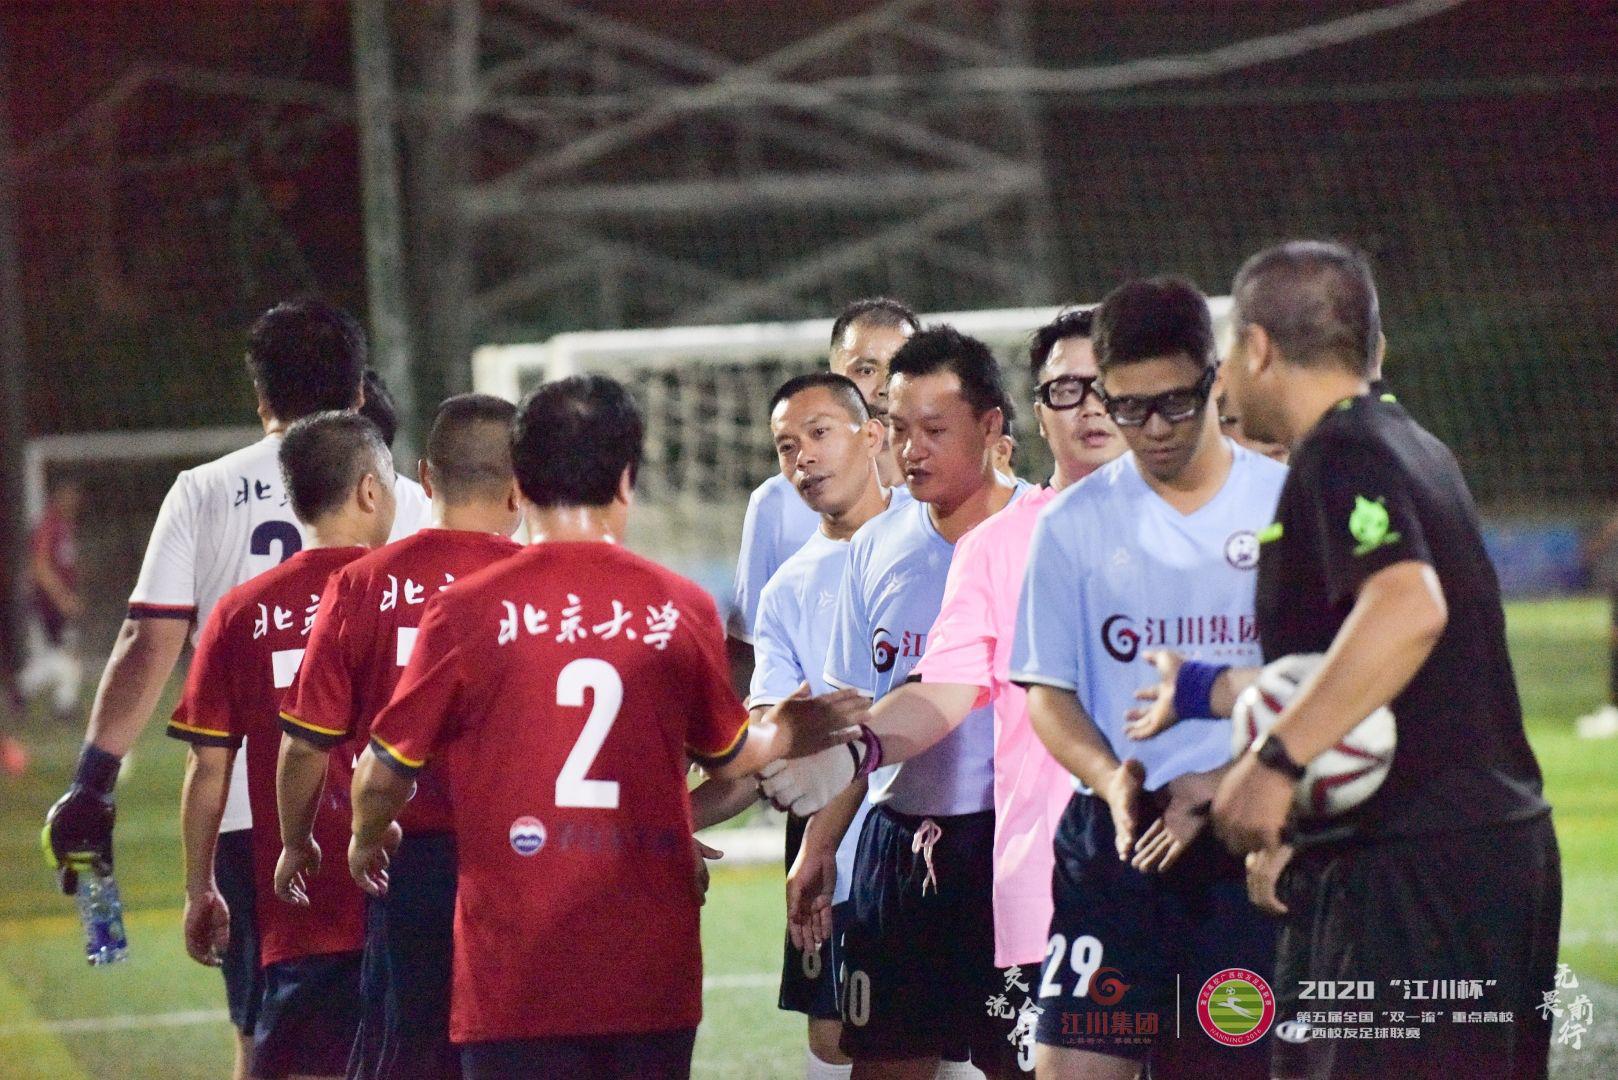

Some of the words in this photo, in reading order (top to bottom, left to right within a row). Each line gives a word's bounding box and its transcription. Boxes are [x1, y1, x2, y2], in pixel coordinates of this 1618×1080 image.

[498, 593, 680, 650] 北京大学
[555, 658, 624, 809] 2
[1039, 933, 1104, 998] 29
